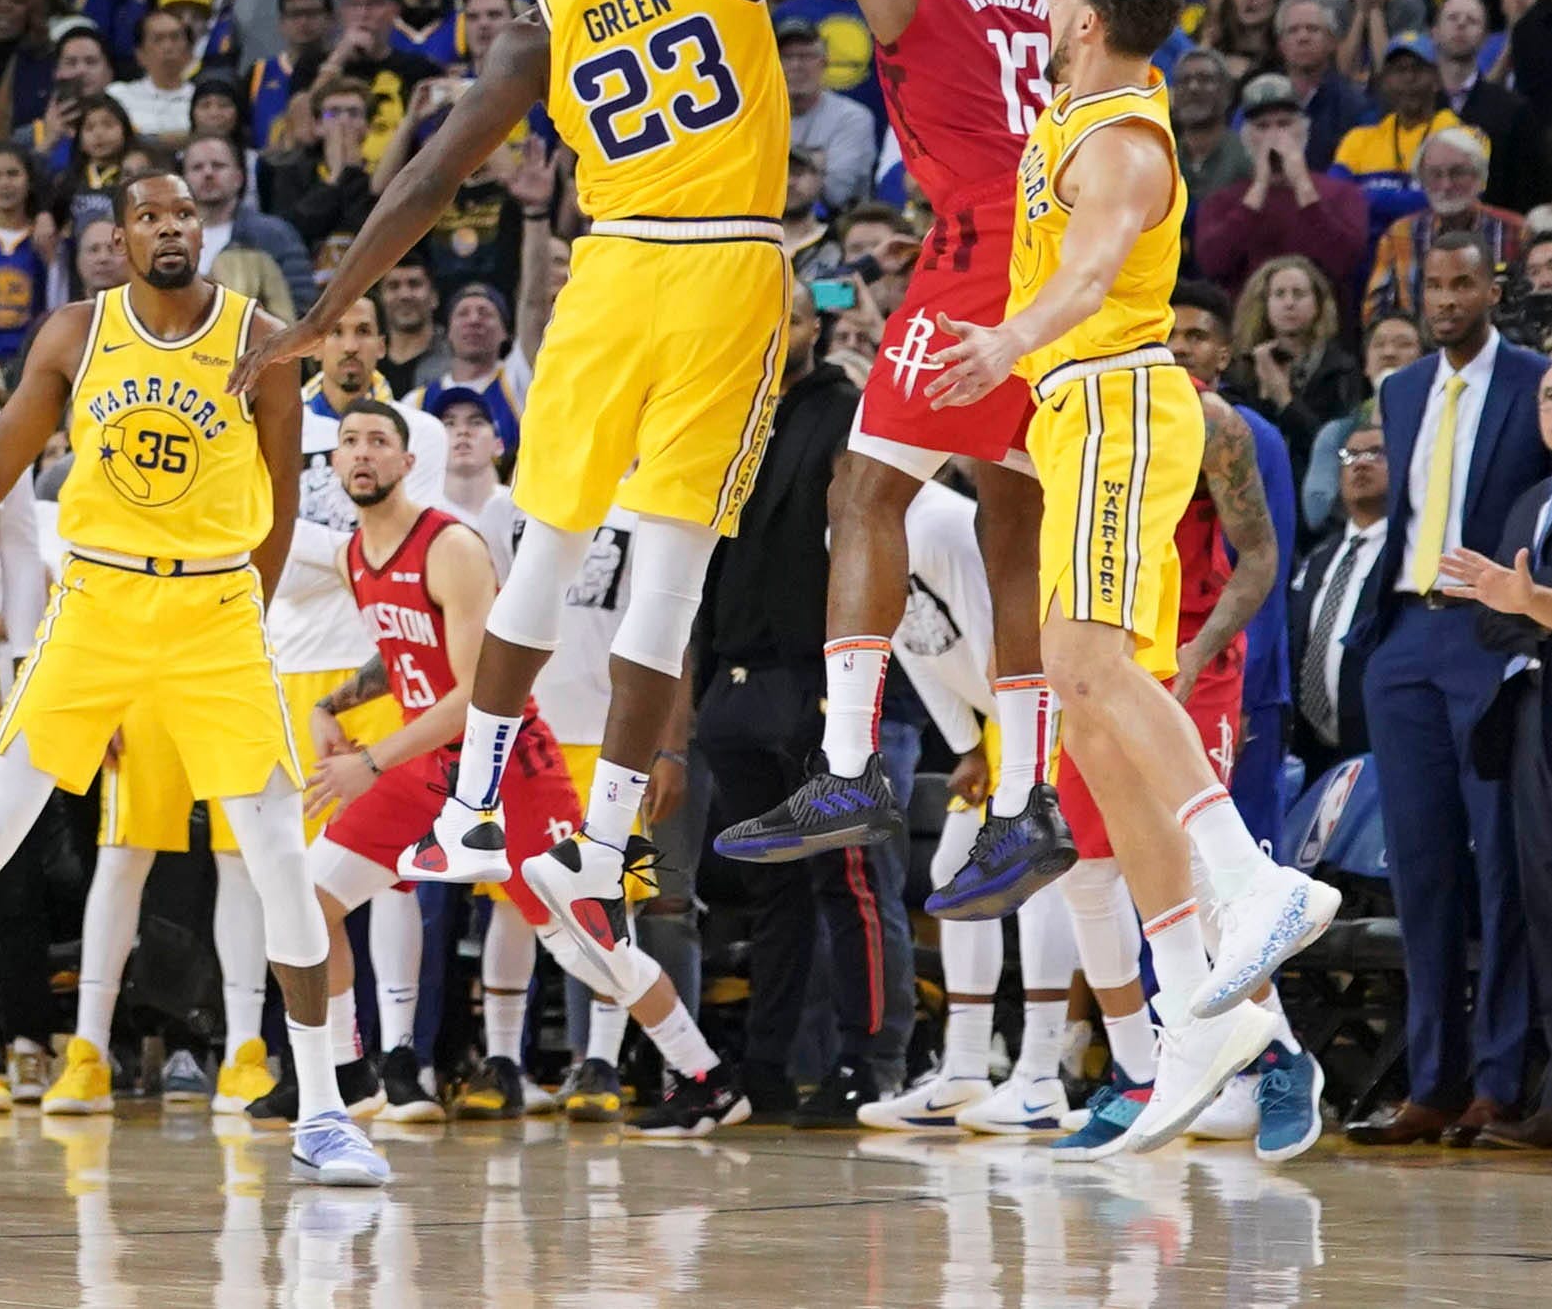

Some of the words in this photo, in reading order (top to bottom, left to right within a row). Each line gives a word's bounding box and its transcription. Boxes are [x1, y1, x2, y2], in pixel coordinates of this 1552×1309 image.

[572, 15, 741, 162] 23
[986, 29, 1053, 134] 13
[89, 377, 227, 440] WARRIORS
[135, 430, 190, 474] 35
[1100, 479, 1124, 604] WARRIORS
[363, 601, 438, 647] STON
